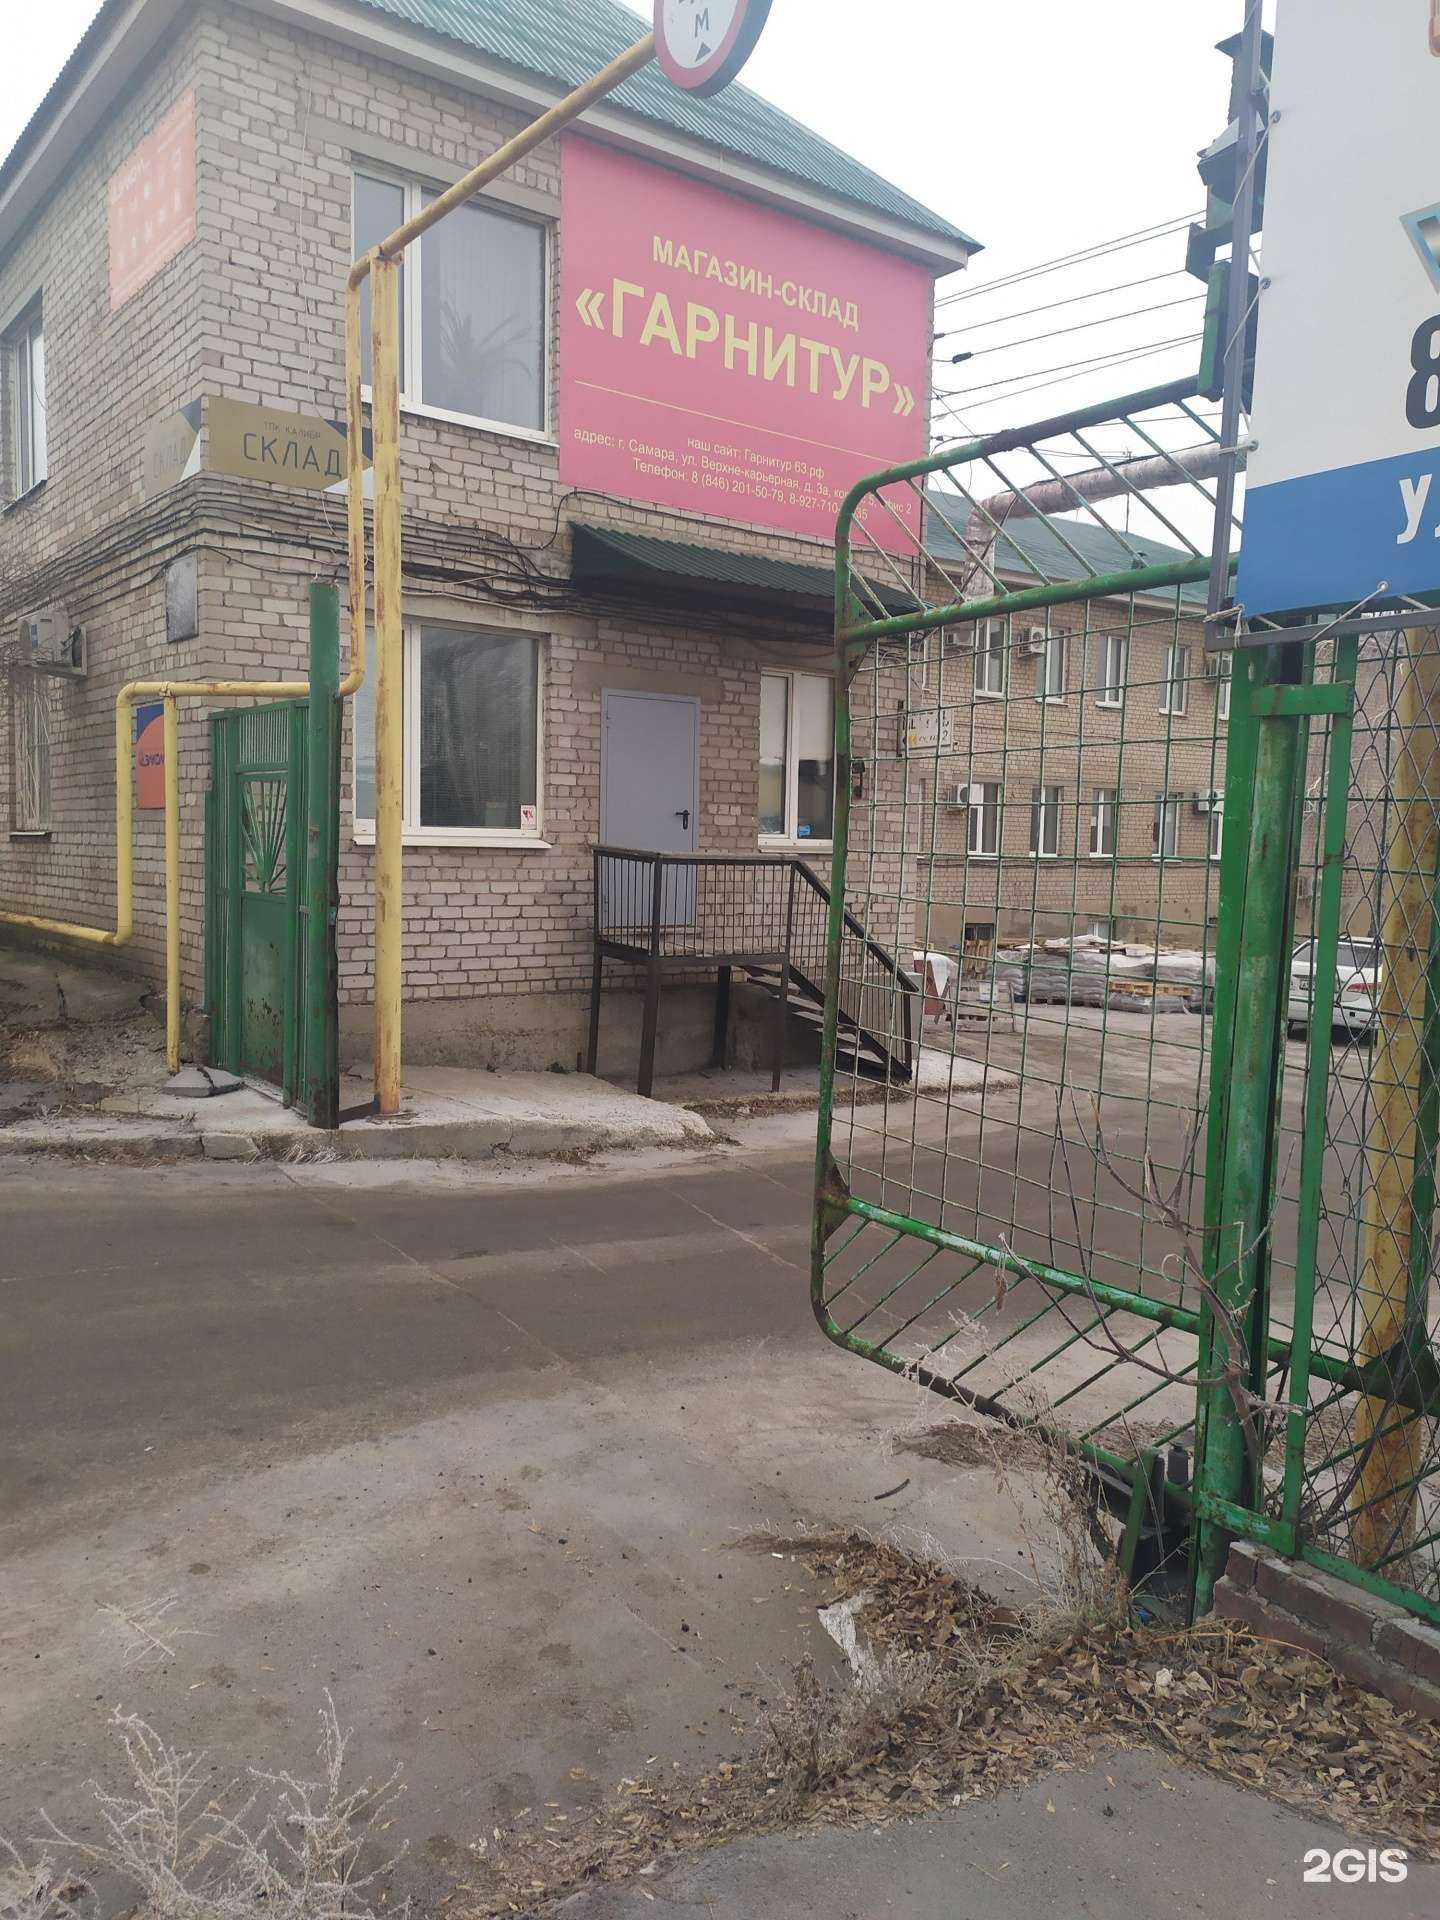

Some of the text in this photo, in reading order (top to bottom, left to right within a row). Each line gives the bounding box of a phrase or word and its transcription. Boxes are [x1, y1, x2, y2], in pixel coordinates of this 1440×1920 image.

[652, 235, 860, 333] МАГАЗИН-СКЛАД
[575, 278, 916, 417] «ГАРНИТУР»
[243, 432, 342, 479] СКЛАД
[574, 428, 615, 448] адрес:
[628, 439, 679, 464] Самара,
[681, 453, 698, 467] ул.
[687, 437, 711, 453] наш
[744, 448, 792, 474] Гарнитур
[633, 457, 690, 481] Телефон:
[691, 470, 699, 484] 8
[701, 472, 730, 491] (846)
